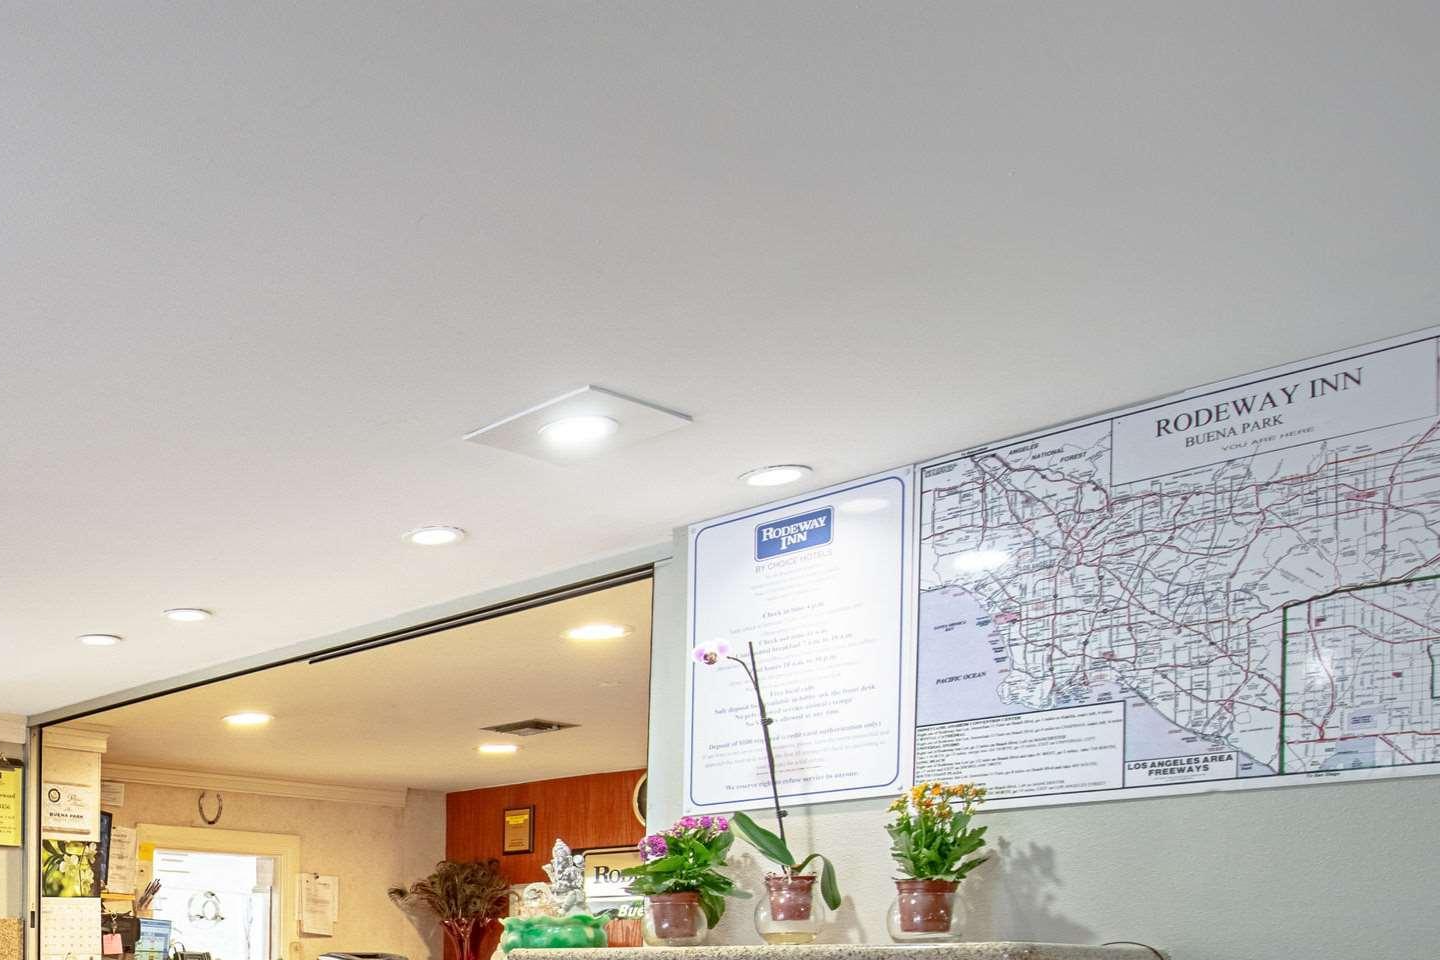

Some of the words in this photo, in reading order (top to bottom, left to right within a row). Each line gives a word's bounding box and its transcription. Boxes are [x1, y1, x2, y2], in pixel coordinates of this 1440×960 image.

[1154, 384, 1300, 437] RODEWAY
[1310, 367, 1365, 399] INN
[1185, 426, 1237, 448] BUENA
[1241, 414, 1284, 435] PARK
[1031, 448, 1064, 460] NATIONAL
[1059, 452, 1087, 462] FOREST
[762, 516, 827, 542] RODEWAY
[779, 531, 809, 550] INN
[936, 674, 961, 685] PACIFIC
[963, 671, 987, 681] OCEAN
[1127, 763, 1148, 771] LOS
[1150, 757, 1200, 769] ANGELES
[1202, 754, 1233, 763] AREA
[1148, 764, 1209, 777] FREEWAYS
